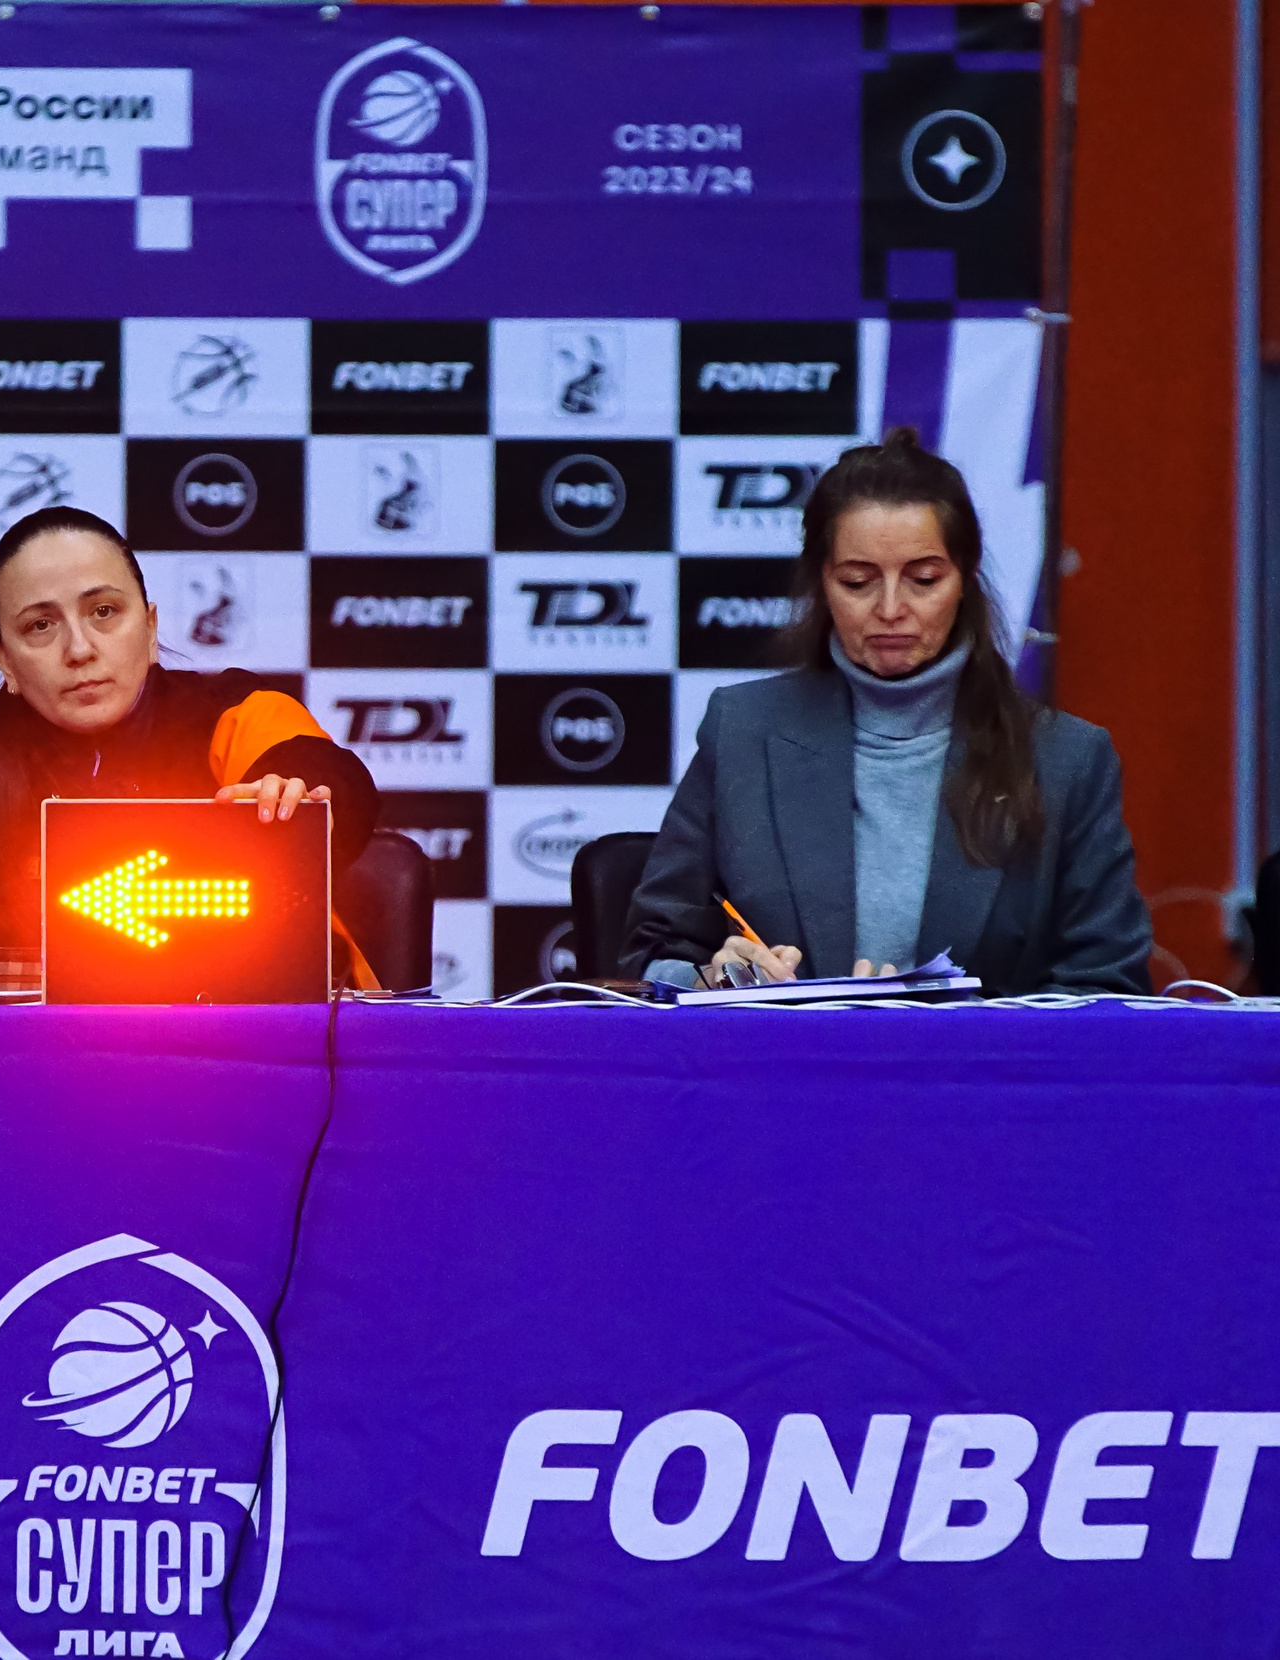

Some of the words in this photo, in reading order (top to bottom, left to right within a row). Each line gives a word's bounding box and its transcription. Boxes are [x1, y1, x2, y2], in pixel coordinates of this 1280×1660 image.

[614, 123, 744, 152] СЕЗОН
[603, 165, 755, 196] 2023/24
[332, 362, 474, 393] FONBET
[700, 362, 841, 394] FONBET
[705, 465, 821, 509] TD
[332, 596, 473, 628] FONBET
[519, 582, 651, 627] TDL
[335, 698, 466, 743] TDL
[24, 1465, 217, 1505] FONBET
[481, 1409, 1280, 1562] FONBET
[16, 1517, 226, 1616] СУПЕР
[54, 1629, 185, 1660] ЛИГА
